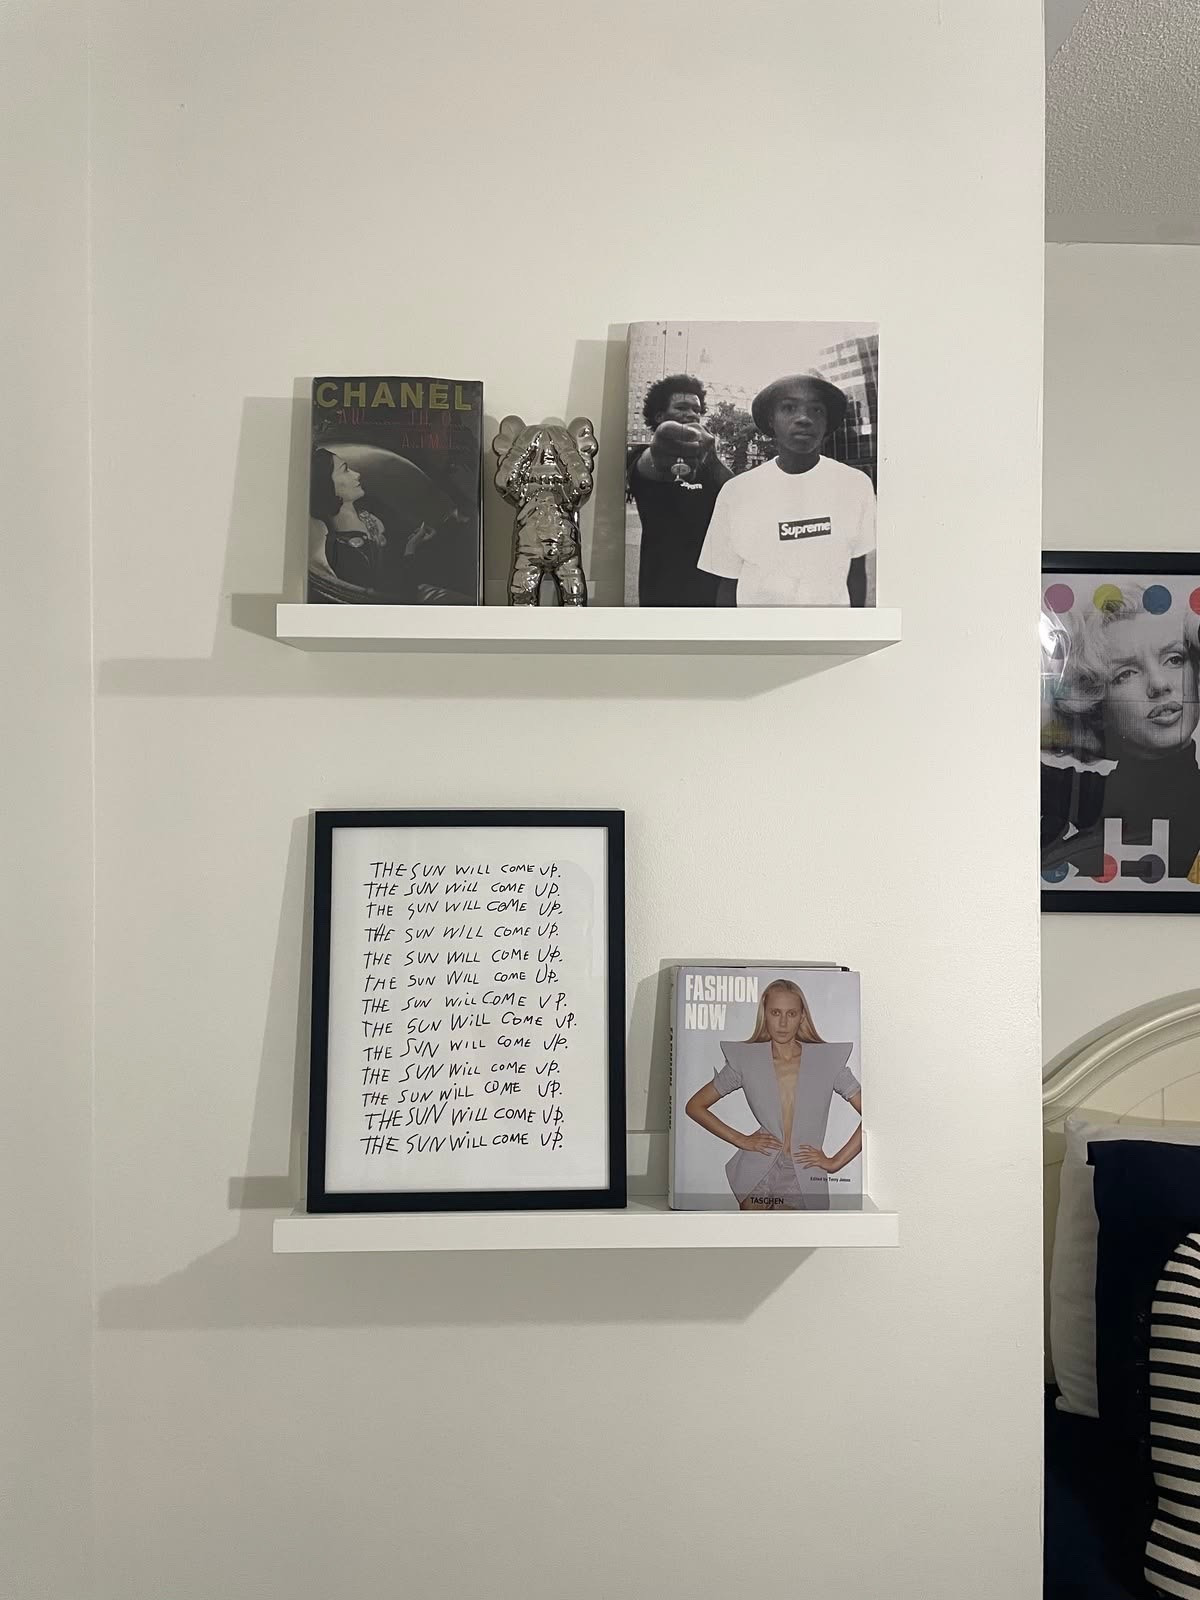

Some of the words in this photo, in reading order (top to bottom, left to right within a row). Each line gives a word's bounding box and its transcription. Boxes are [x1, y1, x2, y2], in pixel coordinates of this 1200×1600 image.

[316, 382, 472, 410] CHANEL
[780, 521, 831, 538] Supreme
[369, 862, 408, 878] THE
[410, 862, 446, 880] SUN
[501, 864, 535, 873] COME
[363, 881, 399, 899] THE
[404, 881, 439, 896] SUN
[491, 882, 526, 893] COME
[366, 902, 394, 918] THE
[408, 900, 439, 920] SUN
[487, 899, 528, 912] COME
[364, 923, 395, 943] THE
[405, 926, 435, 943] SUN
[494, 926, 531, 937] COME
[363, 951, 393, 969] THE
[404, 951, 439, 966] SUN
[492, 949, 530, 962] COME
[364, 974, 398, 992] THE
[408, 975, 436, 987] SUN
[494, 971, 526, 982] COME
[685, 975, 758, 1003] FASHION
[362, 998, 391, 1015] THE
[401, 996, 432, 1011] SUN
[482, 991, 527, 1006] COME
[362, 1021, 393, 1038] THE
[407, 1018, 442, 1034] SUN
[502, 1012, 543, 1026] COME
[685, 1004, 726, 1031] NOW
[363, 1046, 393, 1061] THE
[400, 1038, 440, 1058] SUN
[498, 1035, 532, 1047] COME
[362, 1067, 391, 1085] THE
[399, 1063, 445, 1083] SUN
[491, 1062, 526, 1074] COME
[362, 1092, 389, 1107] THE
[398, 1089, 433, 1104] SUN
[484, 1080, 521, 1095] COME
[365, 1109, 403, 1131] THE
[405, 1101, 448, 1126] SUN
[494, 1108, 536, 1123] COME
[360, 1135, 399, 1155] THE
[407, 1133, 446, 1154] SUN
[492, 1132, 529, 1146] COME
[750, 1197, 784, 1205] TASCHEN
